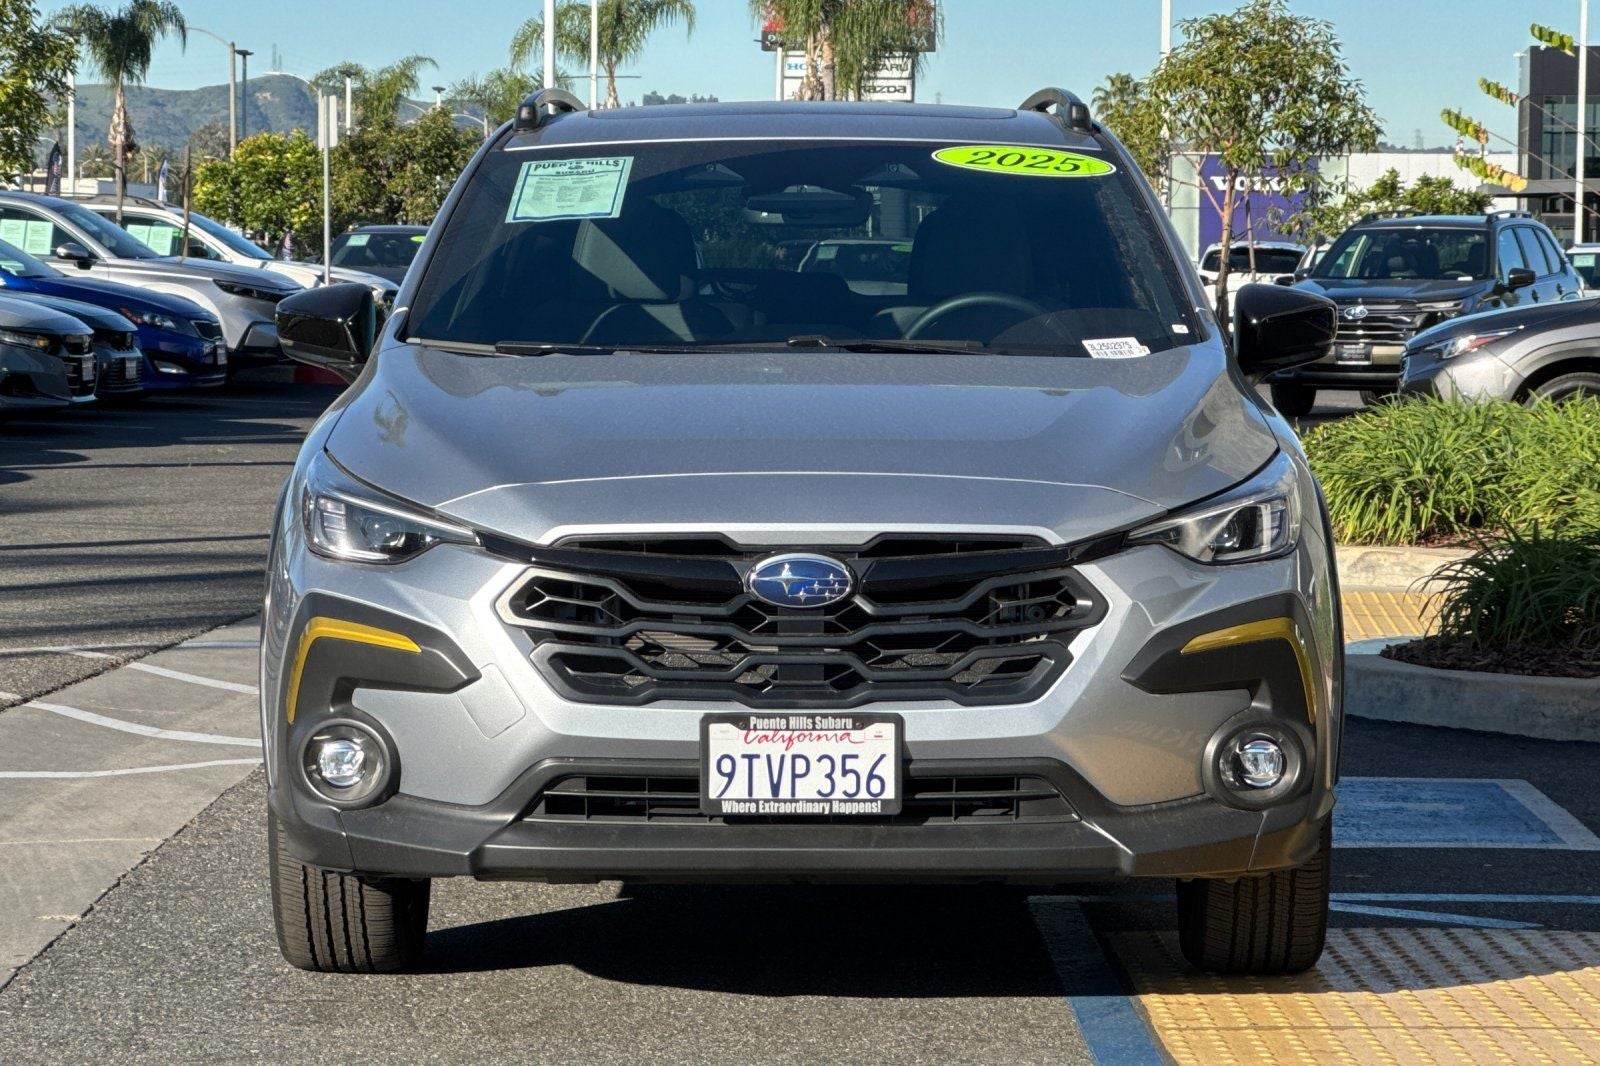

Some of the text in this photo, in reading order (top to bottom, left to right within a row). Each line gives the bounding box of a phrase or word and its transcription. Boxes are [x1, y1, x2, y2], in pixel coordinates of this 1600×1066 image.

[534, 159, 620, 172] PUENTE HILLS
[965, 150, 1085, 173] 2025
[750, 716, 853, 730] Puente Hills Subaru
[743, 729, 865, 751] California
[716, 753, 887, 798] 9TVP356
[721, 800, 881, 814] Where Extraordinary Happens!
